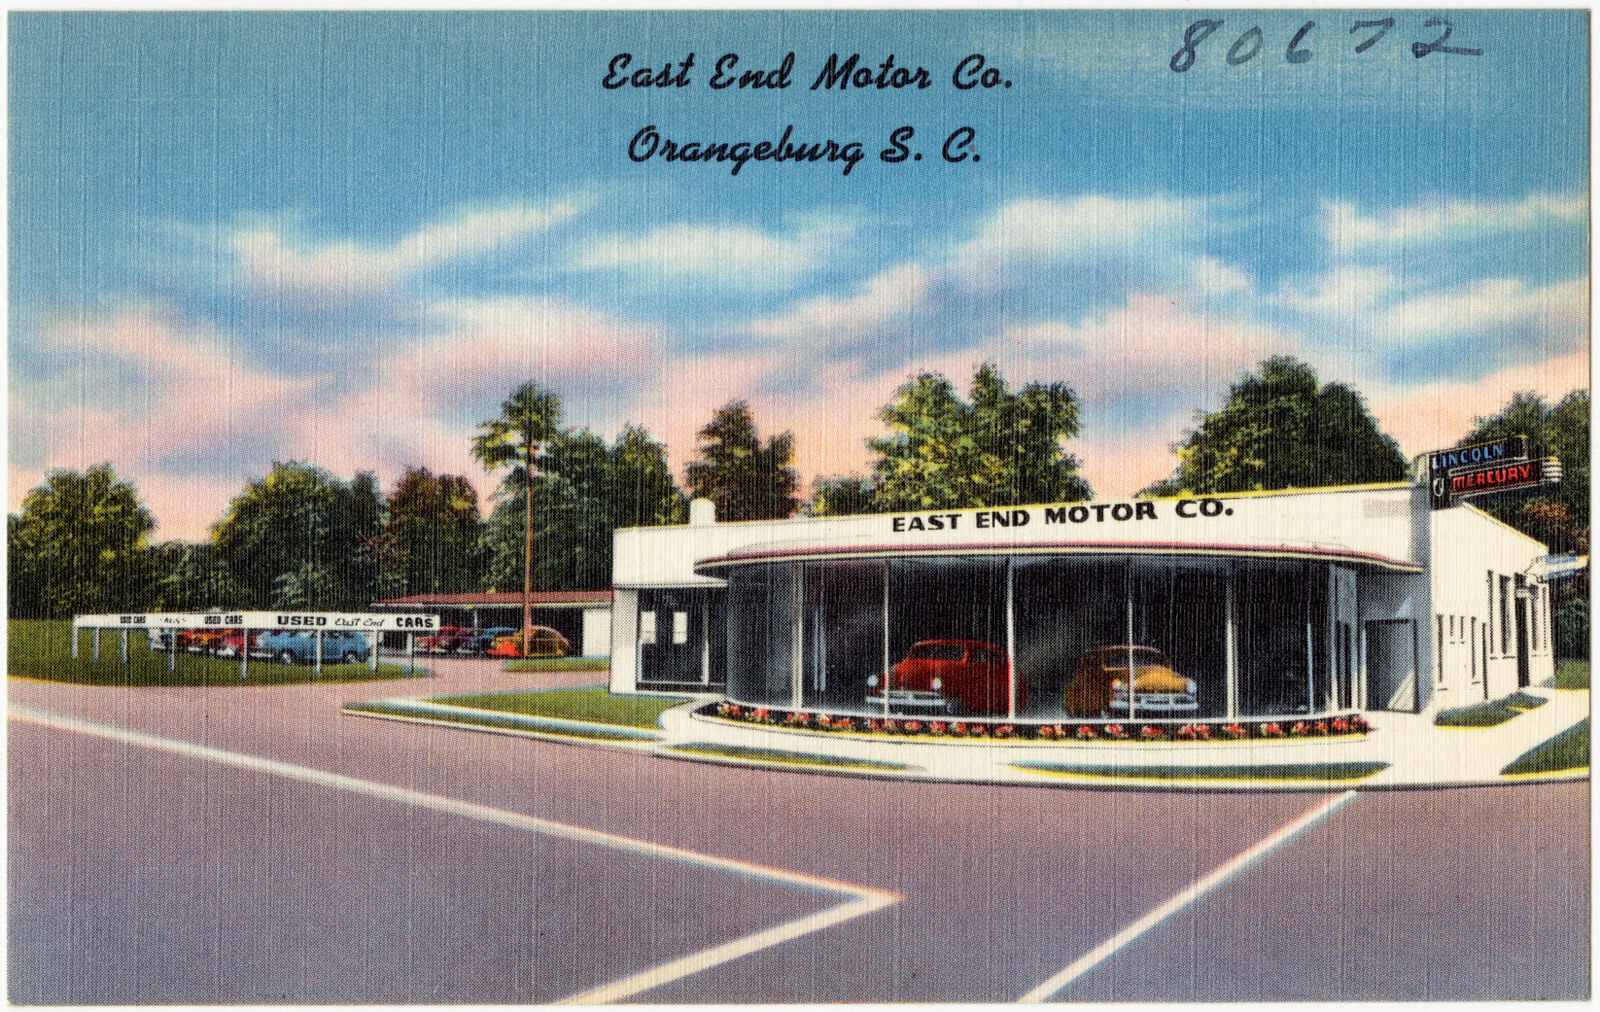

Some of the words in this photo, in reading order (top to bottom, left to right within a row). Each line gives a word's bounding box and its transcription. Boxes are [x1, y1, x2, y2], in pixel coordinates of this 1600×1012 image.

[1170, 17, 1483, 73] 80672
[1432, 443, 1503, 470] LINCOLN
[1452, 464, 1532, 490] MERCURY
[892, 513, 963, 533] EAST
[976, 509, 1031, 529] END
[1045, 502, 1158, 525] MOTOR
[1175, 499, 1235, 519] CO.
[204, 616, 222, 625] USED
[225, 615, 243, 625] CARS
[277, 615, 327, 626] USED
[363, 618, 385, 627] End
[396, 616, 434, 628] CARS
